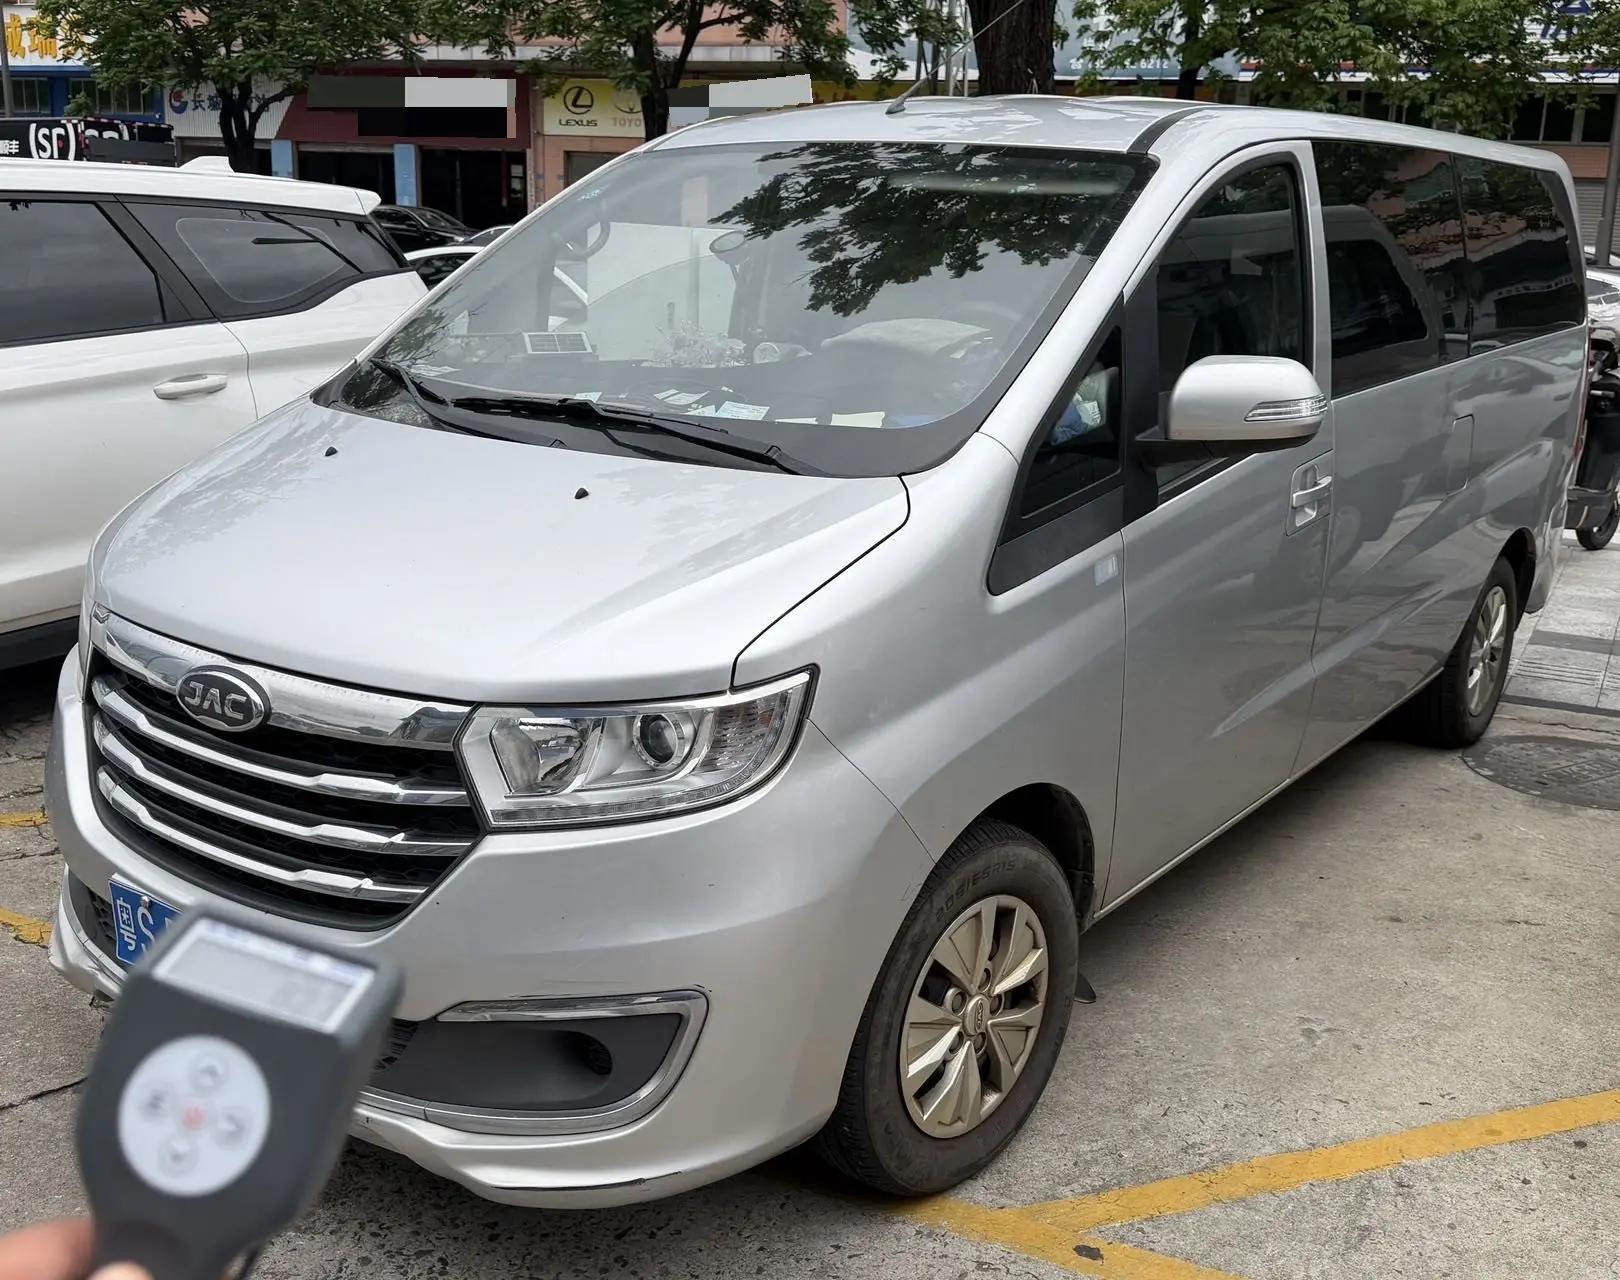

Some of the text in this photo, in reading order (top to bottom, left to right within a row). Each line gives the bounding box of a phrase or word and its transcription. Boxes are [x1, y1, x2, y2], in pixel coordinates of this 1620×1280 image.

[559, 118, 598, 127] LEXUS
[612, 117, 642, 127] TOYO
[185, 681, 247, 720] JAC
